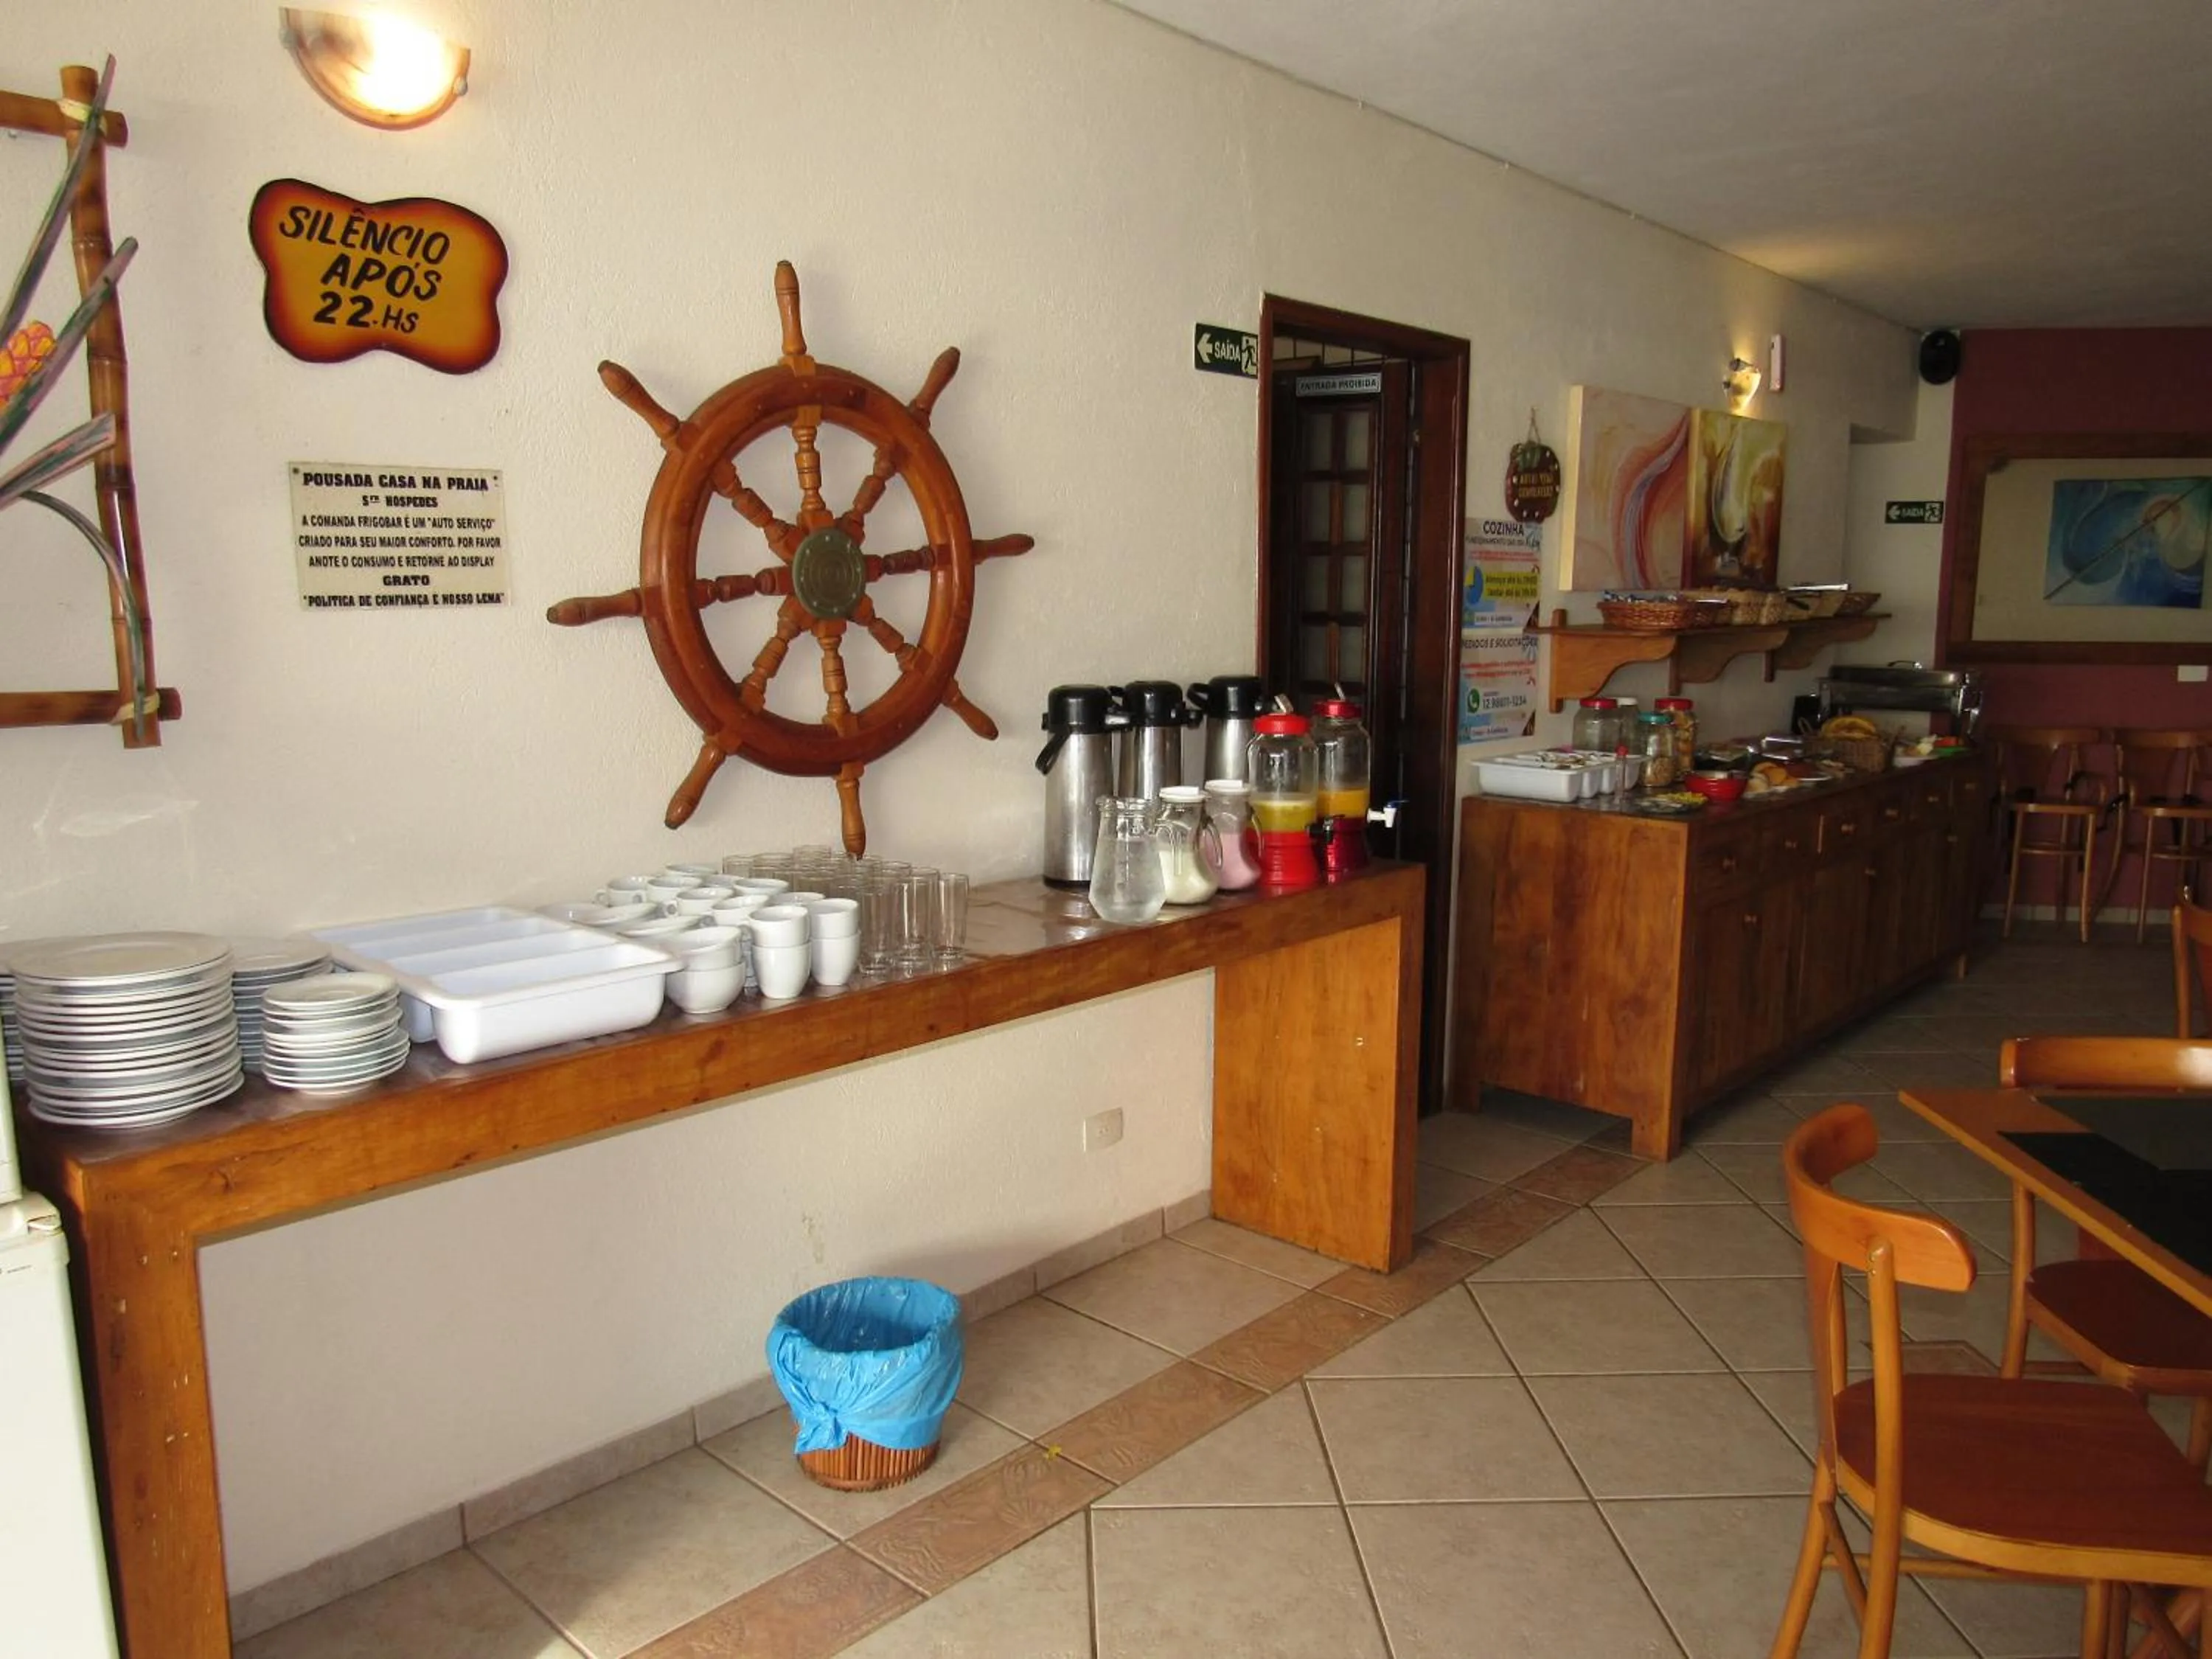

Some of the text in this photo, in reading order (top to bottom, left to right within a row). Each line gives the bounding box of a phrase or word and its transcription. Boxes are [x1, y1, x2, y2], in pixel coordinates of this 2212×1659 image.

[279, 206, 451, 265] SILÊNCIO
[320, 253, 442, 301] APÓS
[1214, 339, 1241, 362] SAÍDA
[1300, 378, 1377, 391] ENTRADA PROIBIDA
[302, 472, 489, 492] POUSADA CASA NA PRAIA
[385, 495, 438, 508] HOSPEDES
[302, 515, 309, 526] A
[310, 515, 355, 527] COMANDA
[358, 515, 403, 529] FRIGOBAR
[412, 517, 425, 528] UM
[1483, 521, 1524, 537] COZINHA
[299, 535, 332, 547] CRIADO
[334, 535, 357, 548] PARA
[359, 536, 377, 548] SEU
[379, 536, 406, 548] MAIOR
[457, 537, 474, 548] POR
[476, 537, 501, 549] FAVOR
[309, 555, 495, 568] ANOTE O CONSUMO E RETORNE AO DISPLAY
[383, 574, 430, 586] GRATO
[358, 595, 372, 606] DE
[375, 594, 429, 608] CONFIANÇA
[442, 593, 474, 605] NOSSO
